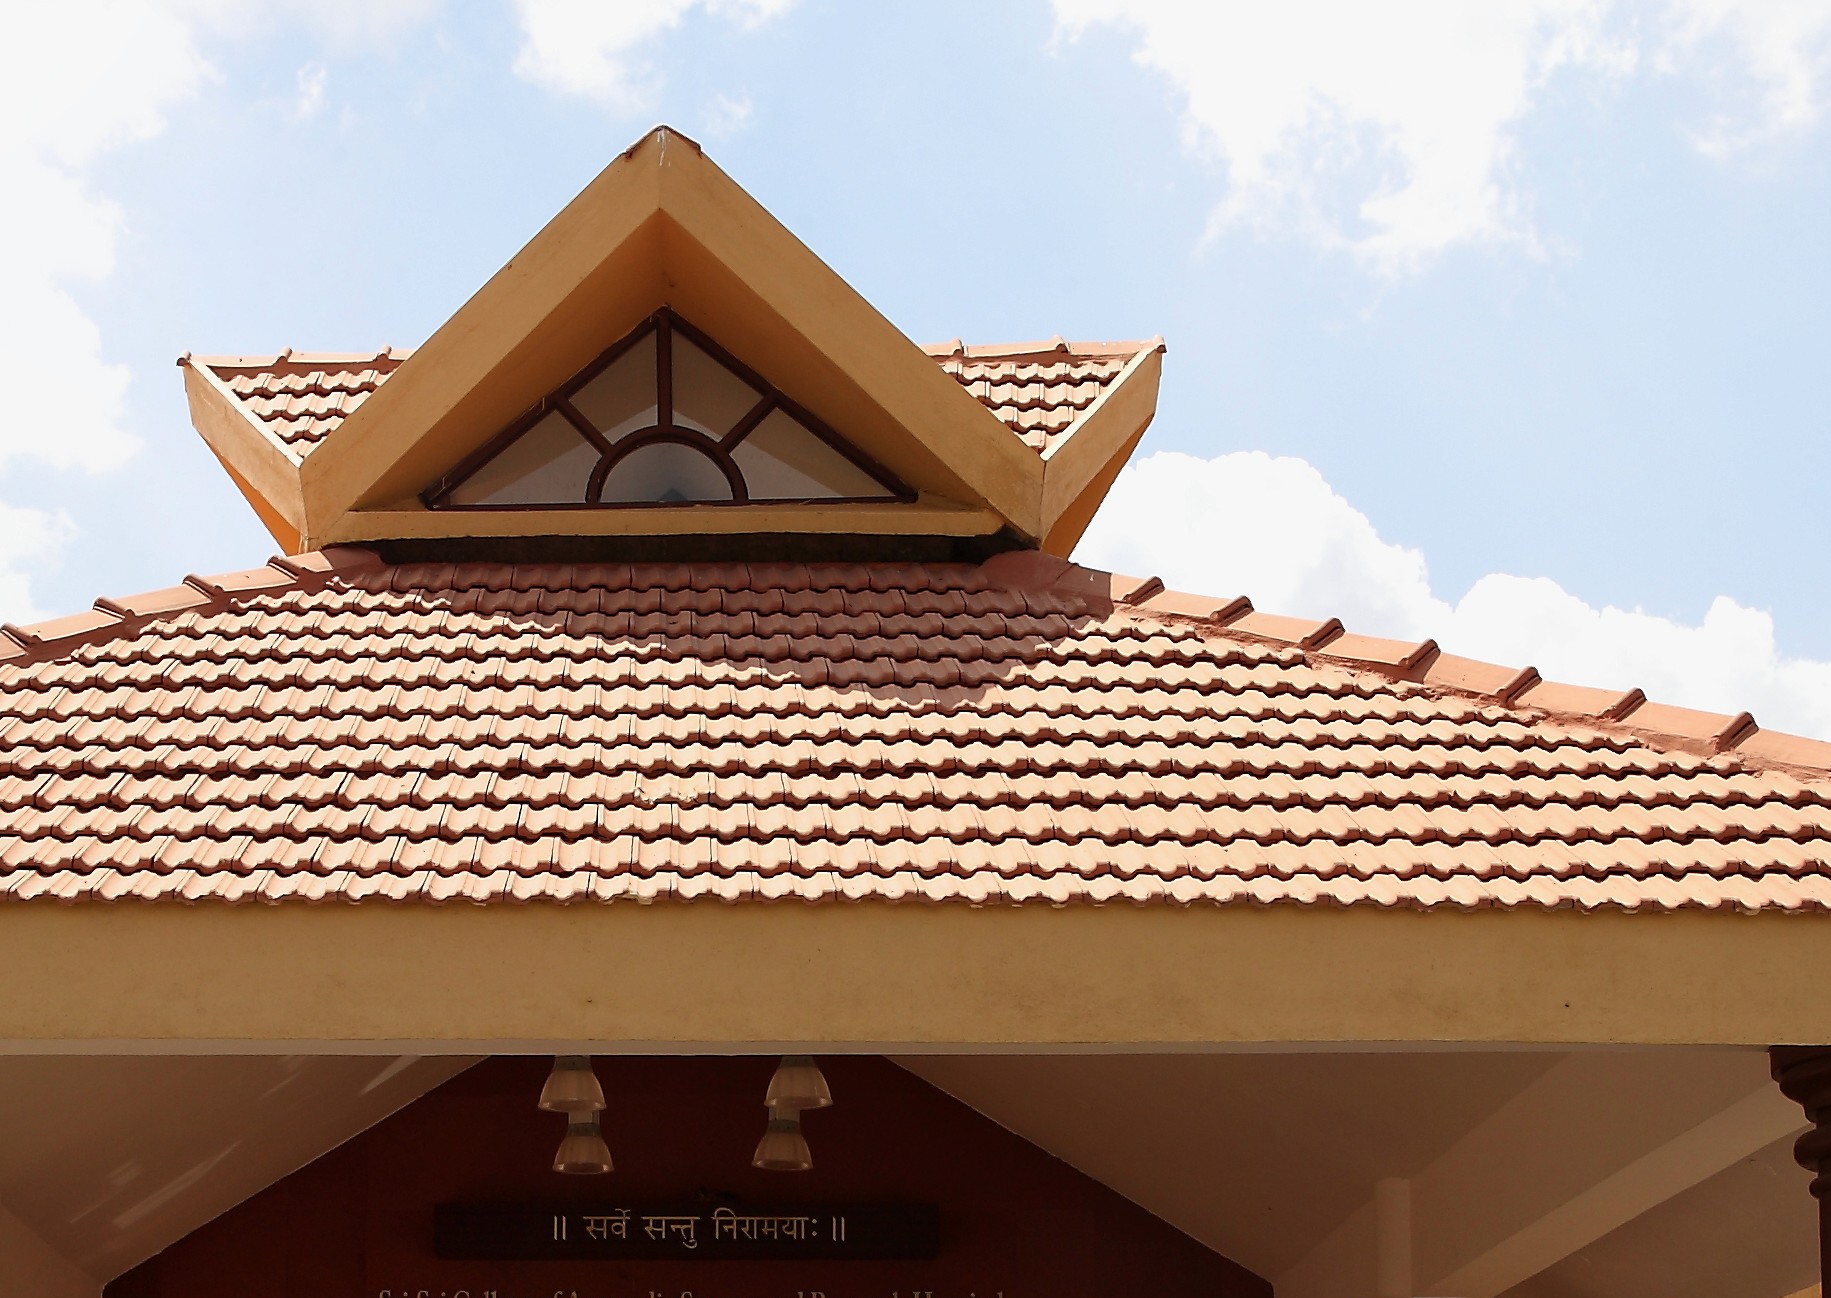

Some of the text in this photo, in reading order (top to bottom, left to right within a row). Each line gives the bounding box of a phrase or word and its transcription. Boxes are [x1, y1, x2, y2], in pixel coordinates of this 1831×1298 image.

[582, 1208, 631, 1240] सर्वे
[640, 1216, 701, 1249] सन्तु
[710, 1207, 818, 1240] निरामयाः
